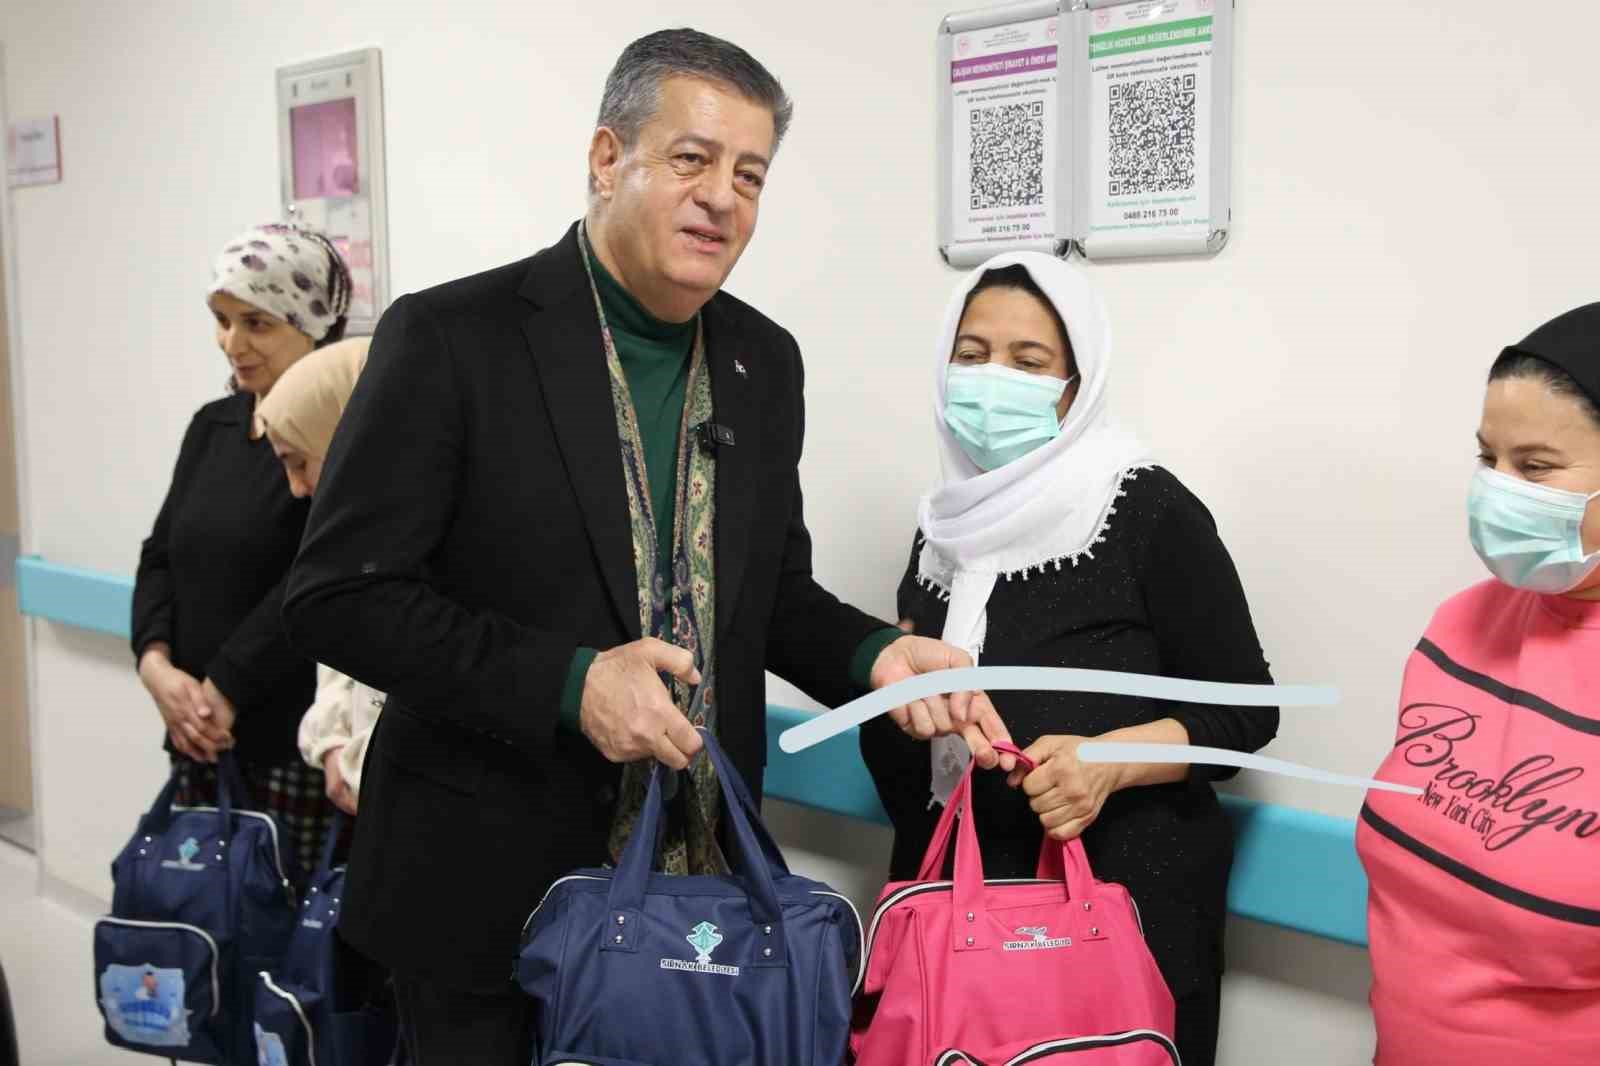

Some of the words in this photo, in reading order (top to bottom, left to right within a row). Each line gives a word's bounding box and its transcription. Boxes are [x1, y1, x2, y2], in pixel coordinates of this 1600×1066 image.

[1169, 208, 1179, 216] 00
[1394, 702, 1600, 852] Brooklyn
[1418, 780, 1445, 811] New
[1442, 794, 1474, 825] York
[1471, 806, 1497, 841] City
